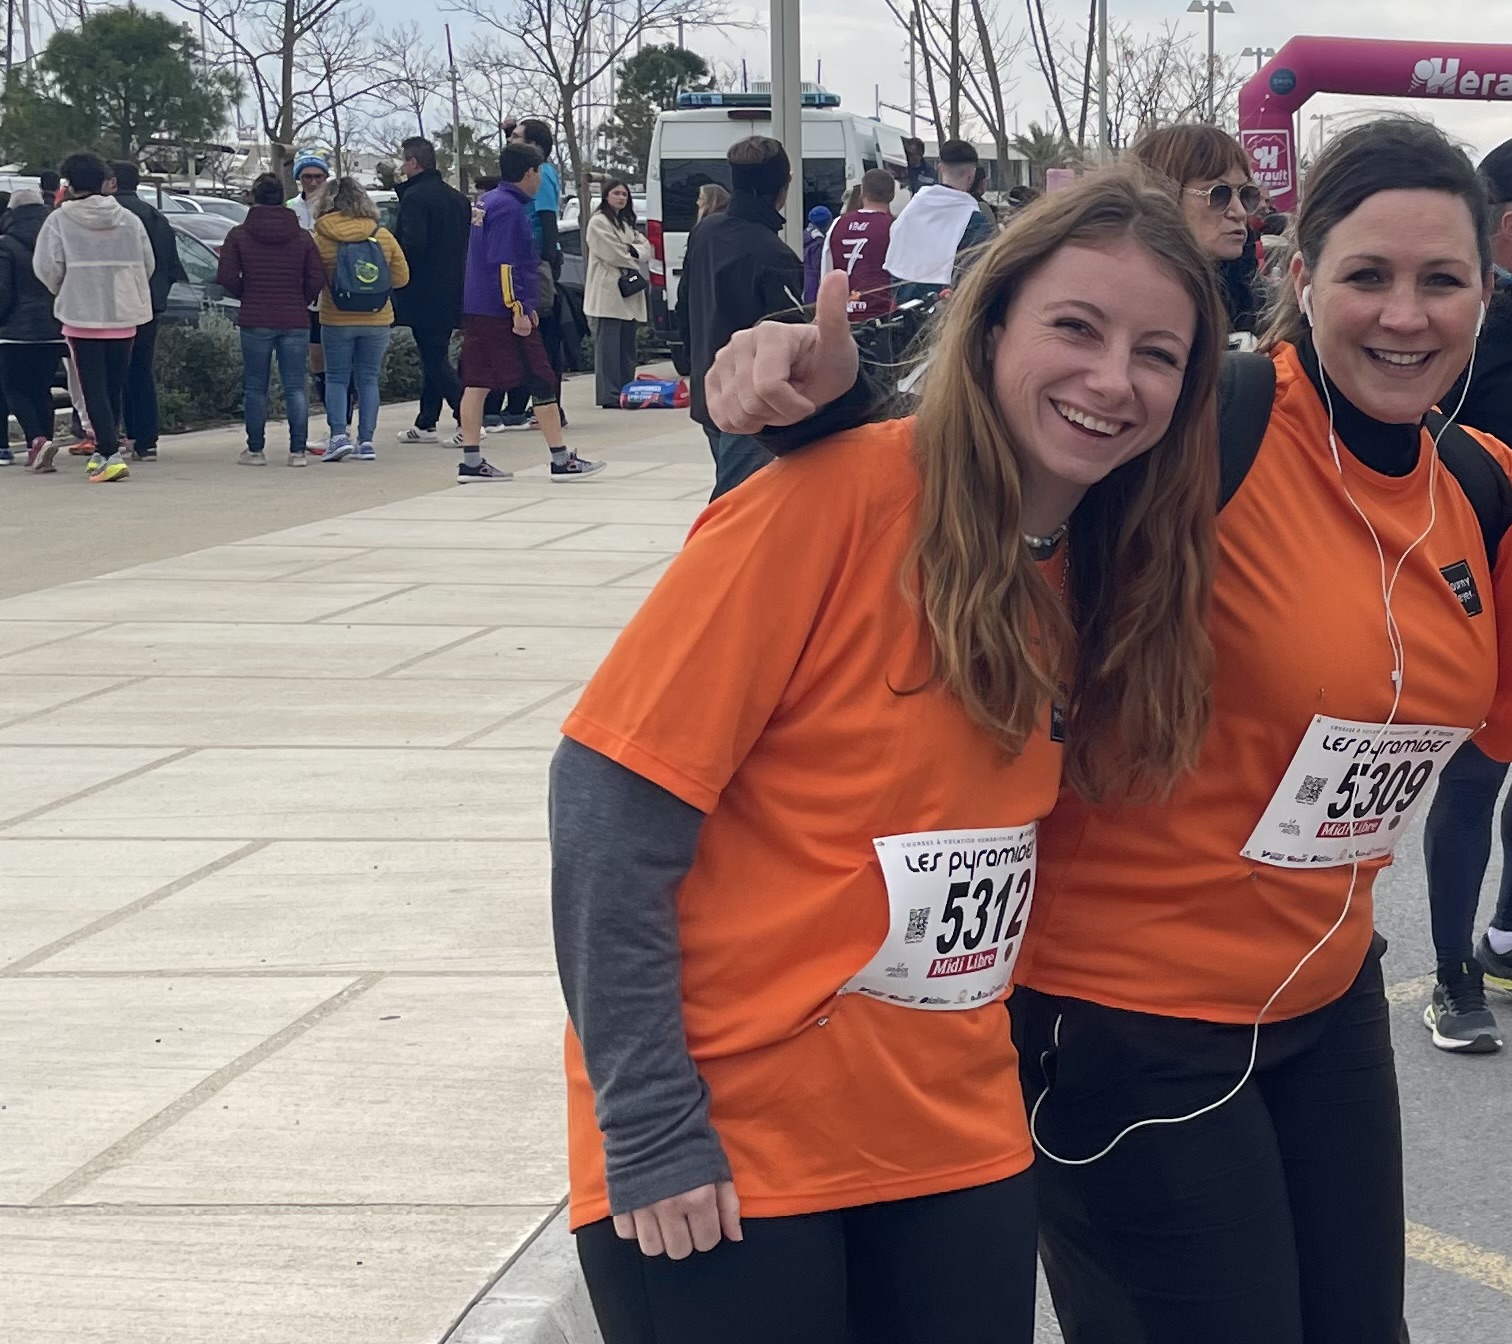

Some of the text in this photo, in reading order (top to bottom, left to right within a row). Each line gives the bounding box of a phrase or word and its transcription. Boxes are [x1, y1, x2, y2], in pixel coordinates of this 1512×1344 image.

[841, 238, 868, 276] 7
[1327, 759, 1434, 819] 5309
[1320, 819, 1379, 837] Midi Libre
[905, 851, 943, 873] LES
[936, 868, 1032, 955] 5312
[932, 953, 996, 975] Midi Libre
